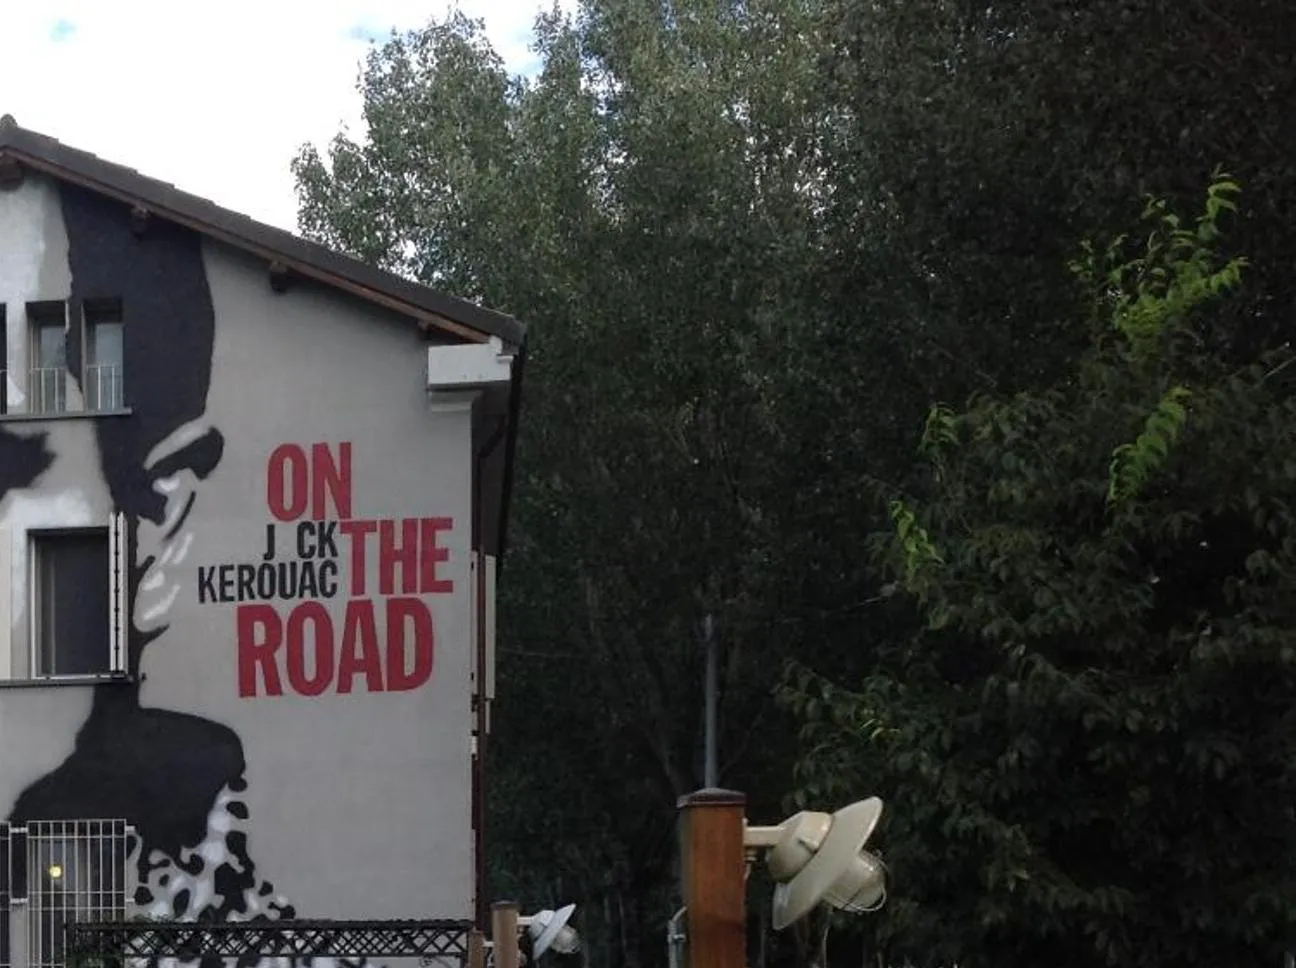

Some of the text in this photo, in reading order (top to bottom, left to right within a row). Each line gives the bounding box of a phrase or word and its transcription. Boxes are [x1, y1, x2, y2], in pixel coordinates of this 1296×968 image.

[267, 442, 352, 521] ON
[263, 521, 338, 561] JCK
[340, 517, 453, 596] THE
[198, 560, 338, 604] KEROUAC
[237, 597, 434, 698] ROAD
